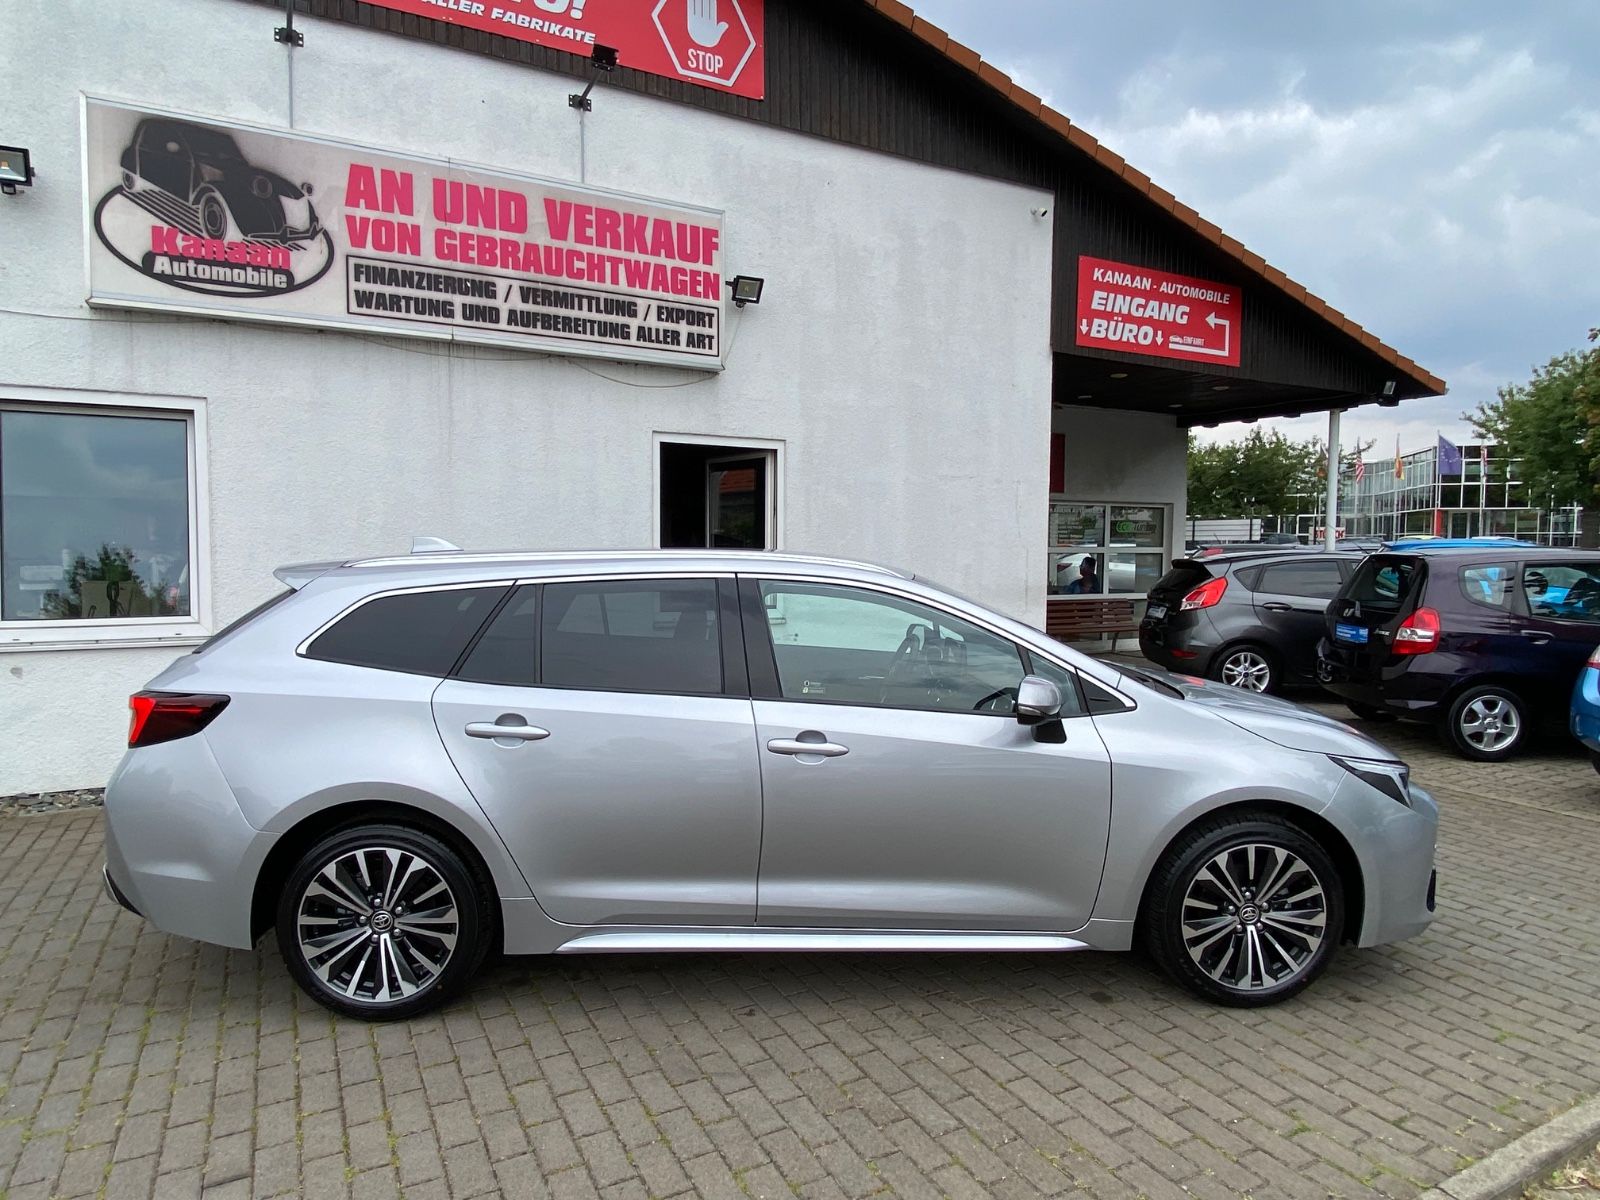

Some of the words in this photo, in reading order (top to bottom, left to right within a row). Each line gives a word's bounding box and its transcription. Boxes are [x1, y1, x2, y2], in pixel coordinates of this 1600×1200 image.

[491, 7, 596, 44] FABRIKATE
[687, 48, 724, 74] STOP
[345, 163, 415, 216] AN
[432, 178, 528, 234] UND
[543, 198, 720, 266] VERKAUF
[151, 225, 291, 270] Kanaan
[345, 215, 421, 257] VON
[434, 228, 720, 301] GEBRAUCHTWAGEN
[153, 256, 288, 289] Automobile
[1093, 267, 1152, 290] KANAAN
[1159, 281, 1231, 305] AUTOMOBILE
[354, 263, 497, 300] FINANZIERUNG
[519, 285, 639, 319] VERMITTLUNG
[656, 305, 715, 329] EXPORT
[1091, 290, 1190, 325] EINGANG
[354, 289, 455, 319] WARTUNG
[462, 303, 500, 324] UND
[507, 308, 631, 340] AUFBEREITUNG
[636, 325, 681, 346] ALLER
[686, 332, 715, 350] ART
[1089, 316, 1154, 346] BÜRO
